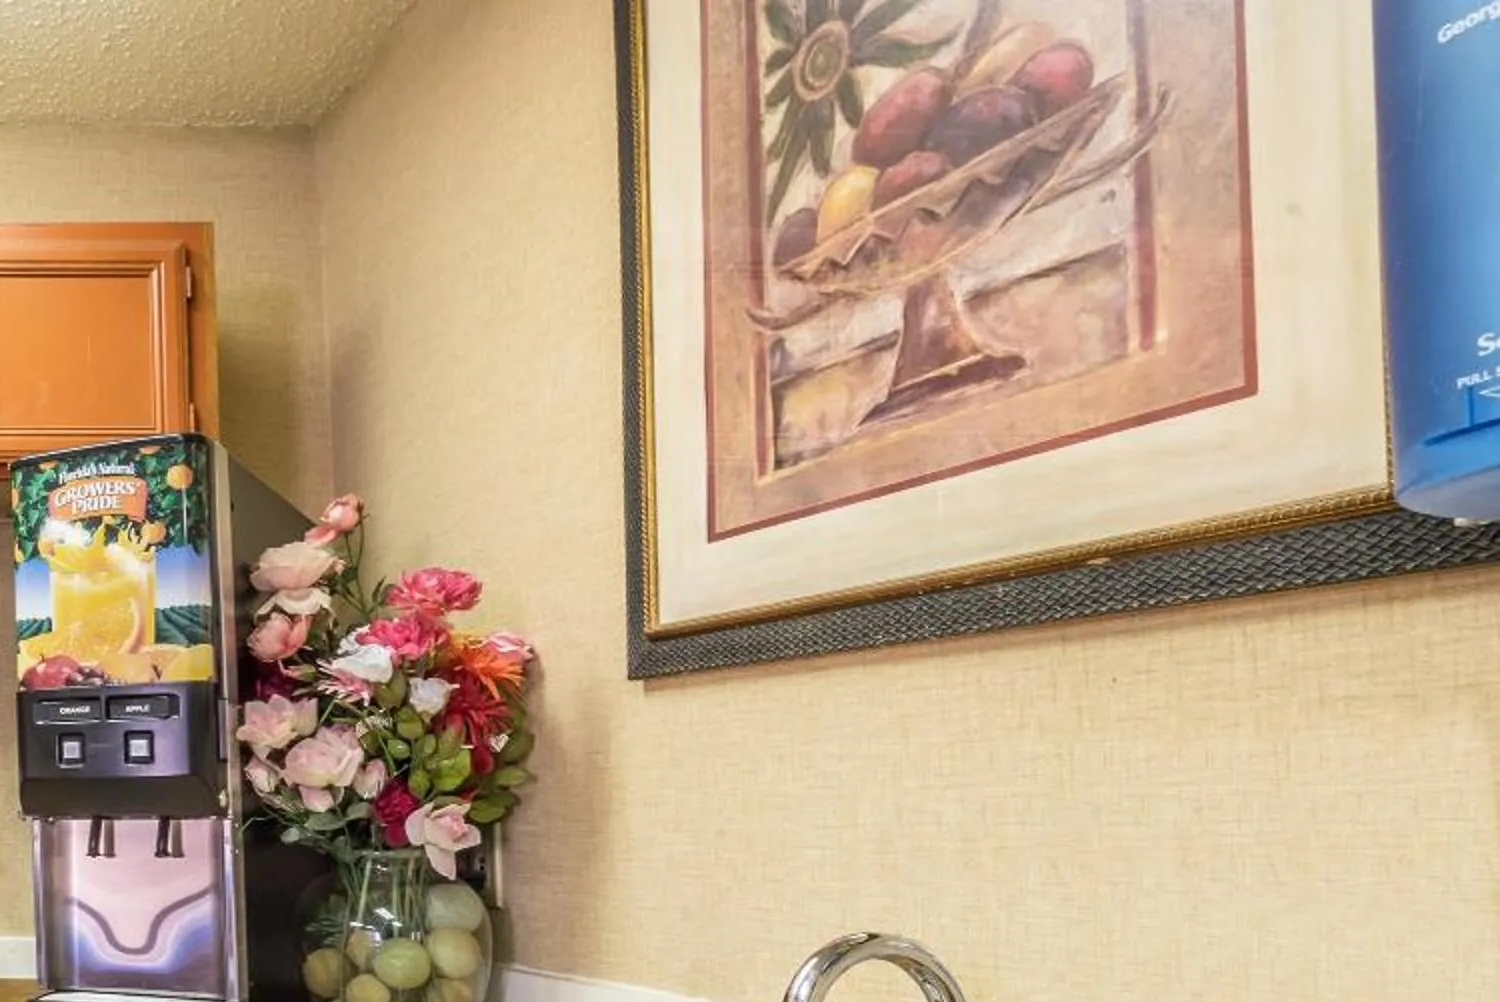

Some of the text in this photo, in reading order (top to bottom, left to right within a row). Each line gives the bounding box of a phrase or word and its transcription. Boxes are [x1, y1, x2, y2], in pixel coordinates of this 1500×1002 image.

[1456, 370, 1493, 390] PULL
[70, 496, 122, 516] PRIDE
[59, 704, 91, 716] ORANGE
[125, 703, 151, 714] APPLE
